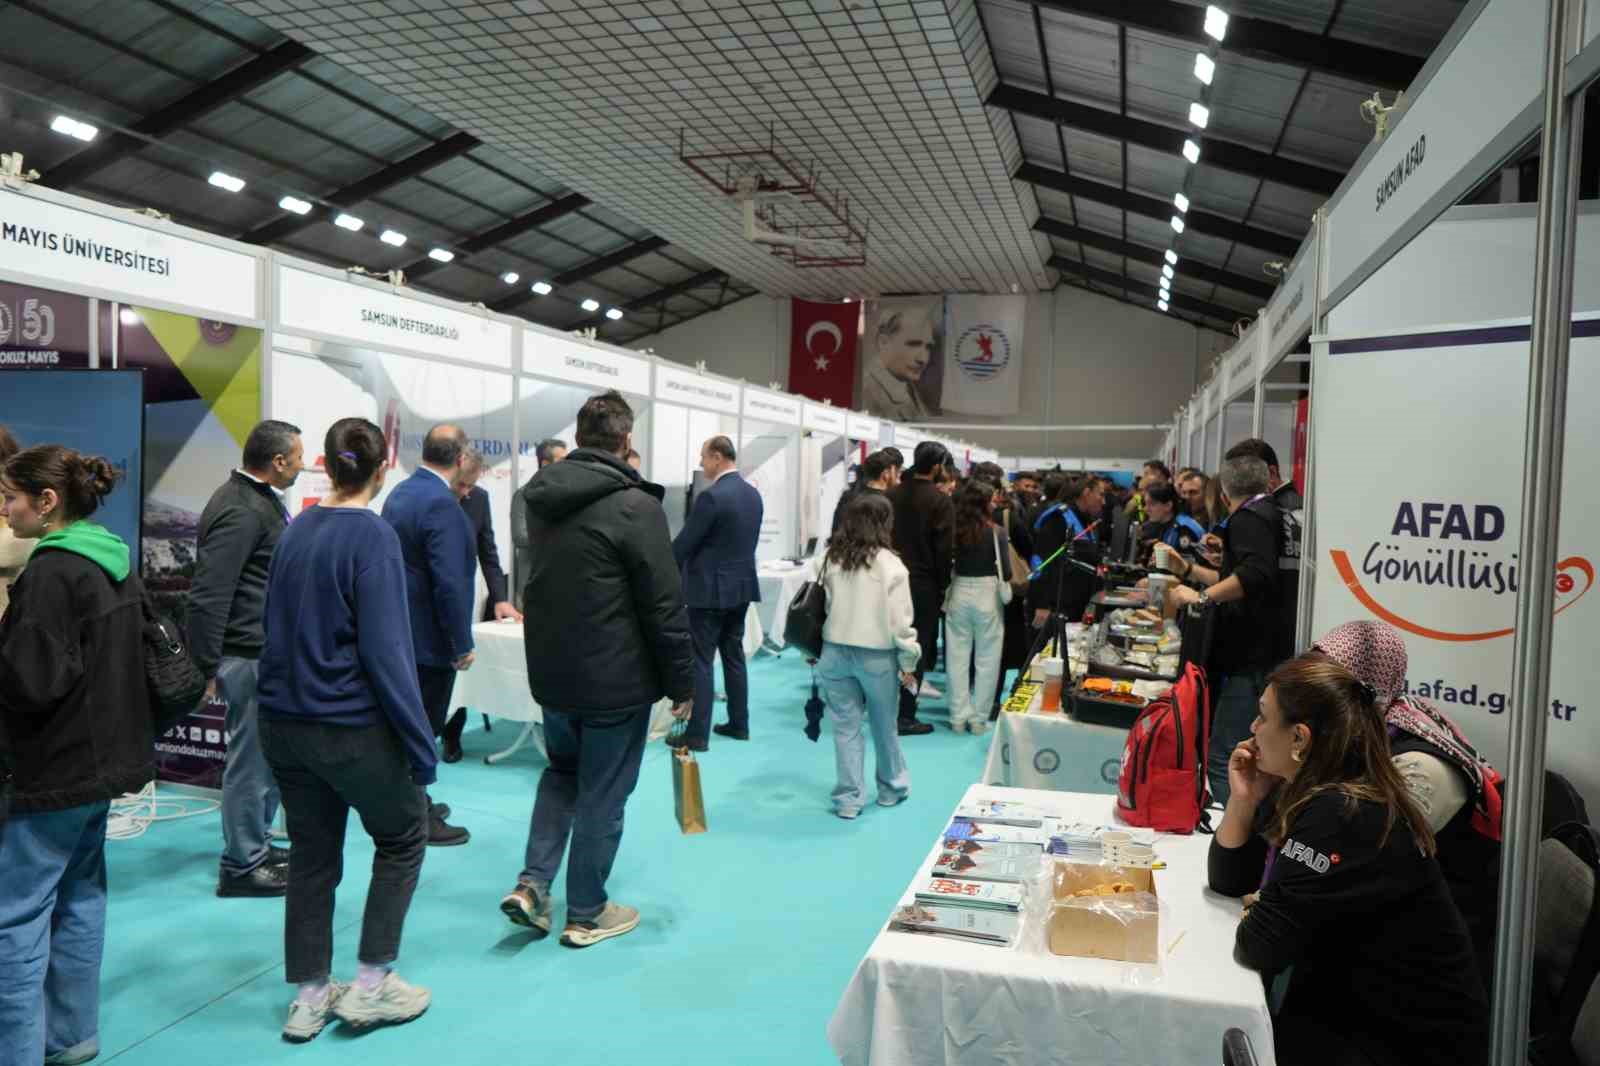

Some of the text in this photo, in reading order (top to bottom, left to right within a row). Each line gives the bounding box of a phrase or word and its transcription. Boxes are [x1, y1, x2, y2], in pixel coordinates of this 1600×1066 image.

[1404, 134, 1425, 182] AFAD
[2, 221, 169, 276] MAYIS ÜNİVERSİTESİ
[361, 308, 398, 328] SAMSUN
[1391, 501, 1505, 542] AFAD
[1280, 838, 1330, 873] AFAD
